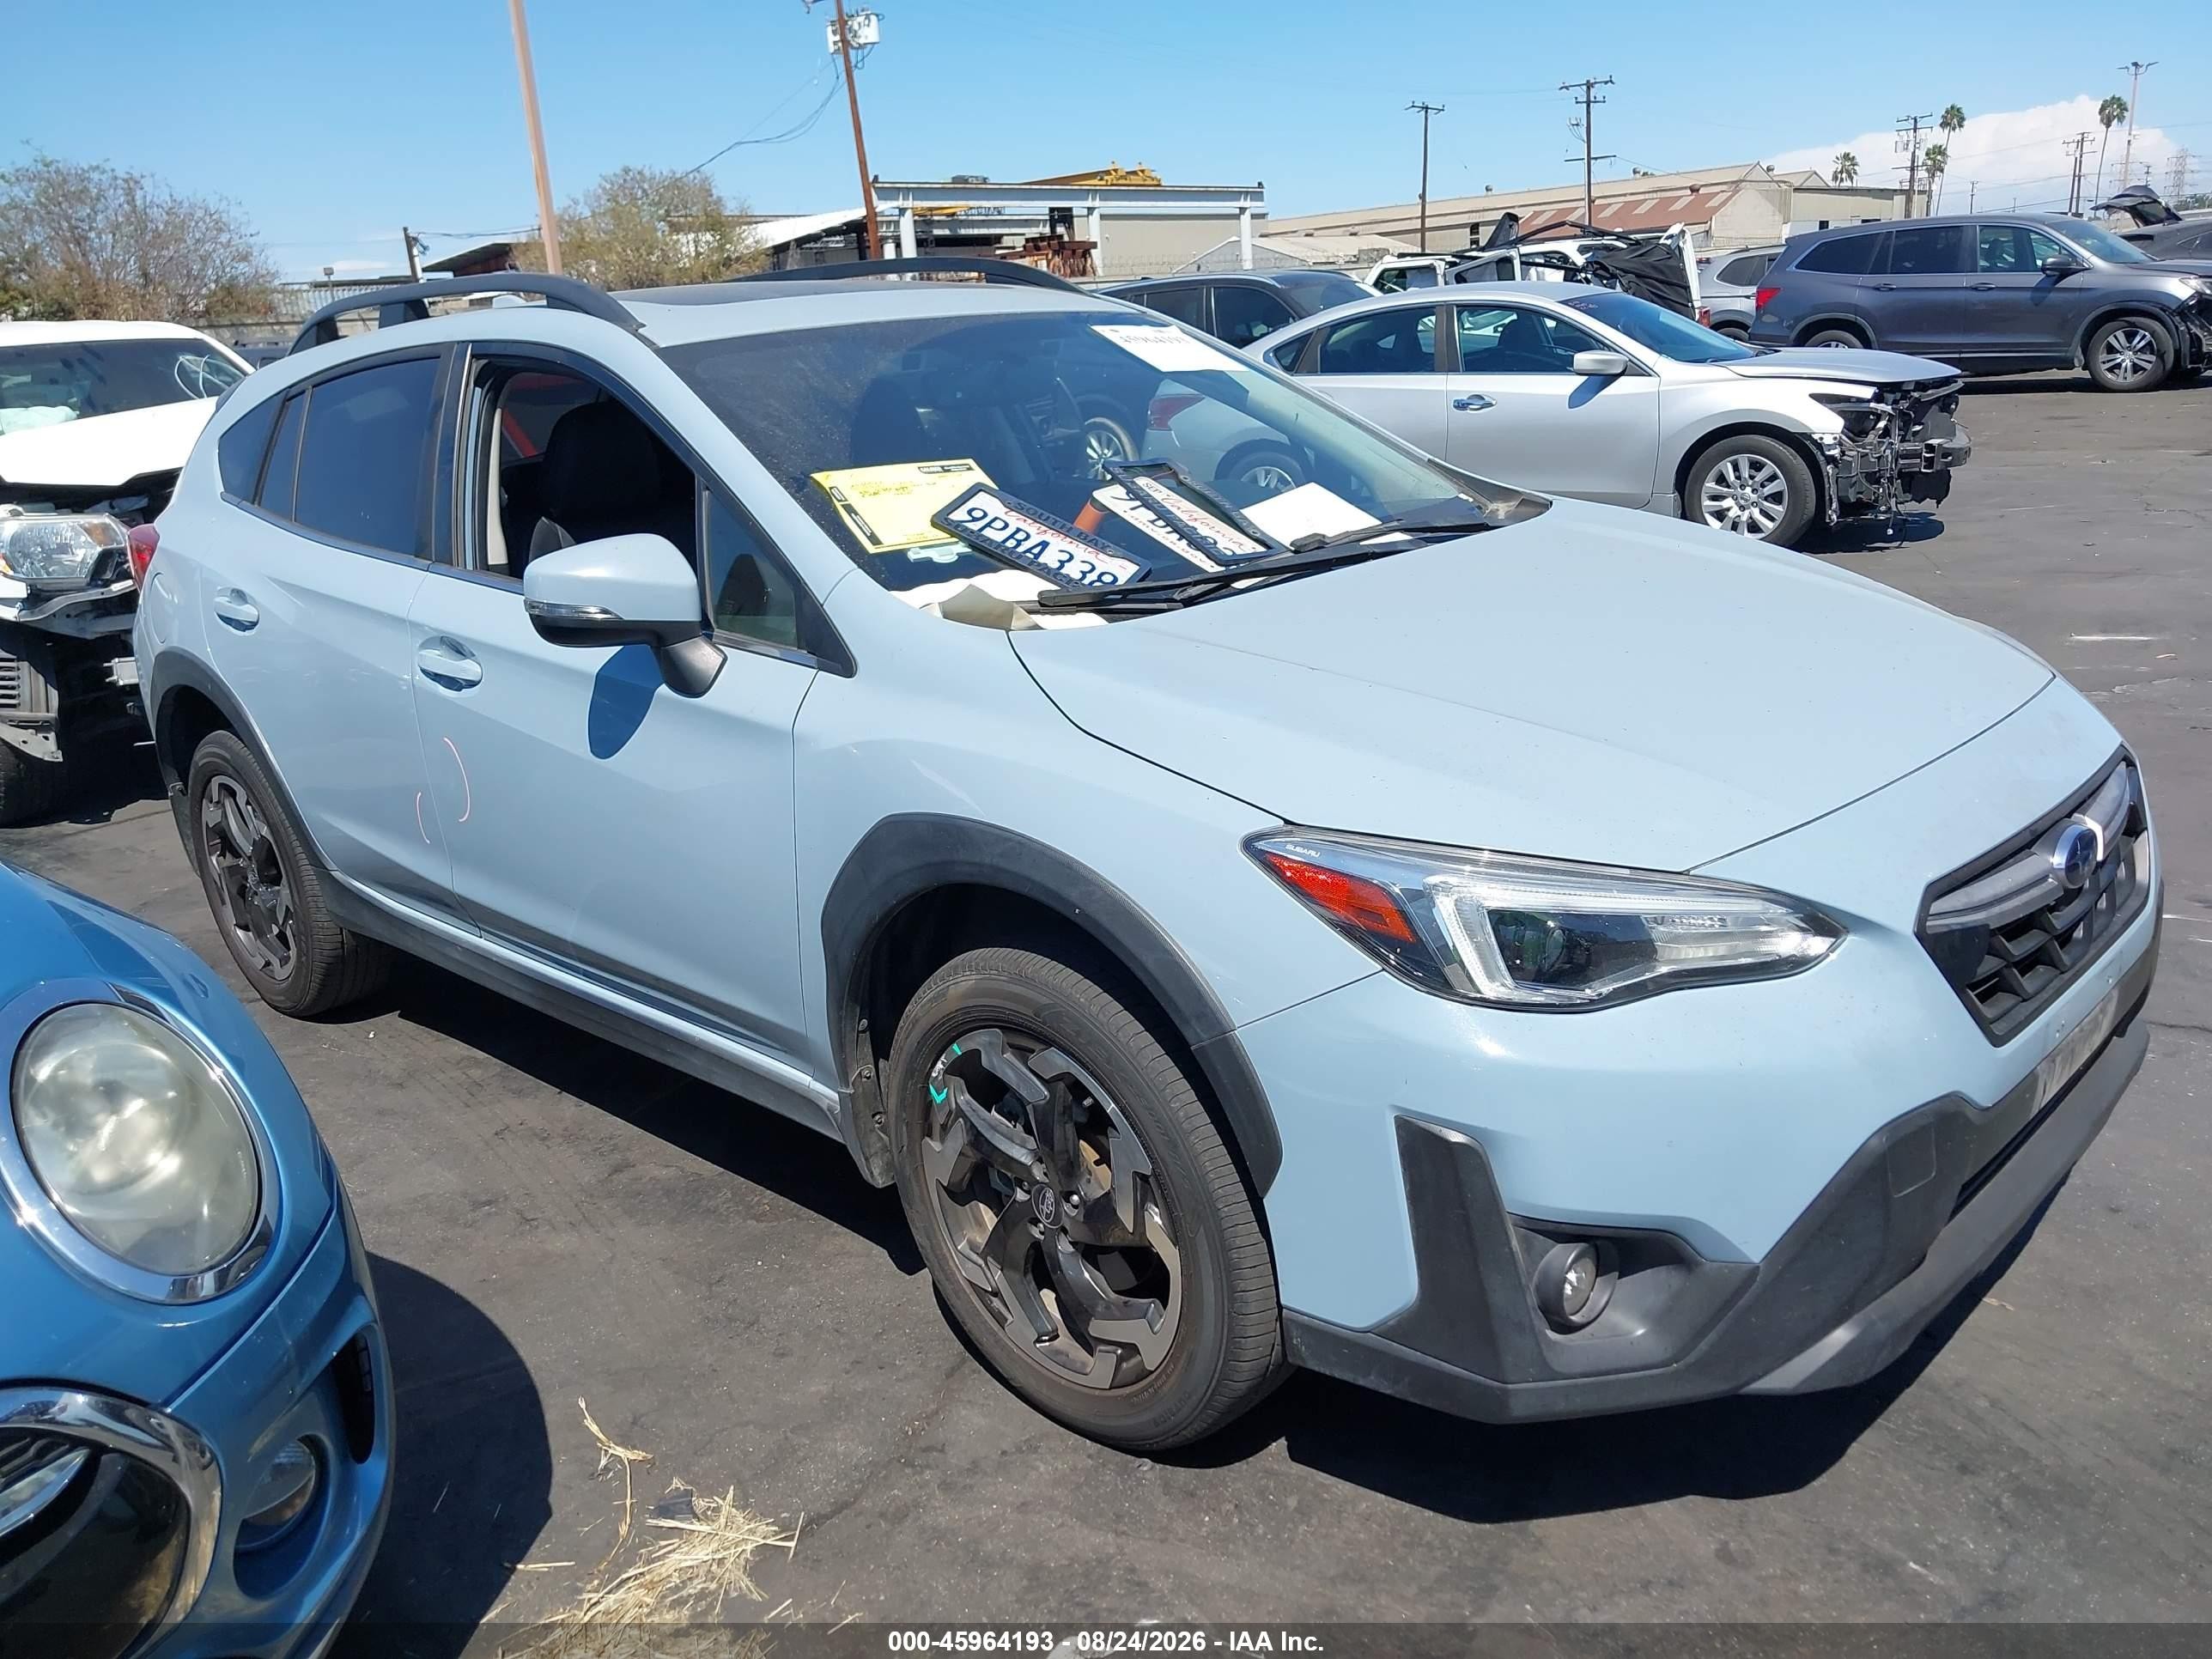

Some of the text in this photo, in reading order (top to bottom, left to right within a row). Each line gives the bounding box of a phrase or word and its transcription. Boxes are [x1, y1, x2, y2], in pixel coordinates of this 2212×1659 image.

[942, 518, 1024, 561] SUBARU
[954, 507, 1120, 586] 9PBA338
[1004, 509, 1109, 564] California
[1017, 501, 1110, 552] SOUTH BAY
[1285, 844, 1321, 857] SUBARU
